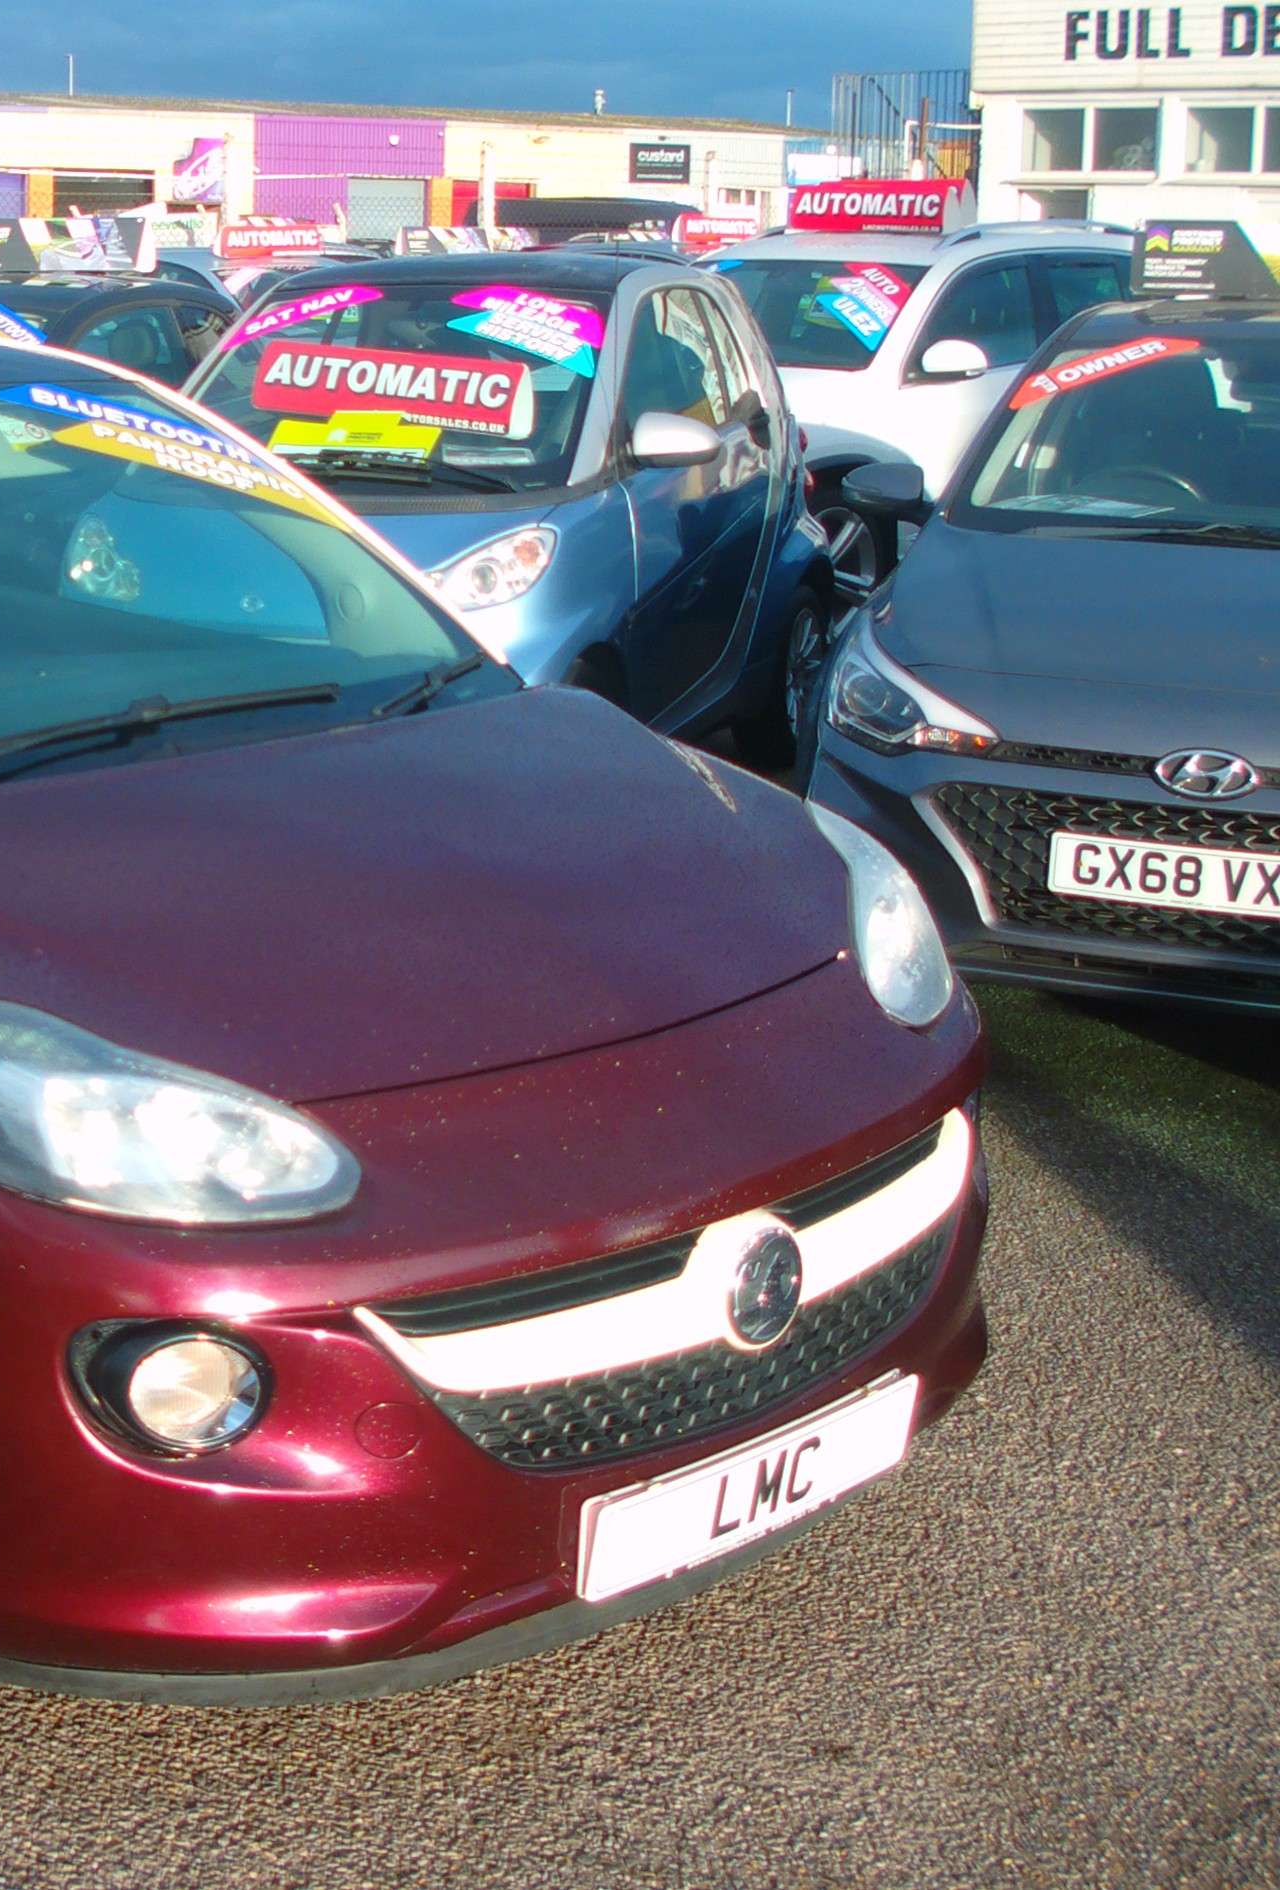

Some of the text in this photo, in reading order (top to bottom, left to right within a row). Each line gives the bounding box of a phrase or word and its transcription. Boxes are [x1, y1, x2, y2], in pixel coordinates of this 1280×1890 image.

[1065, 7, 1192, 60] FULL
[637, 149, 684, 162] custard
[796, 192, 940, 217] AUTOMATIC
[227, 230, 318, 247] AUTOMATIC
[687, 220, 757, 234] AUTOMATIC
[860, 268, 900, 295] AUTO
[245, 308, 295, 335] SAT
[301, 290, 353, 315] NAV
[480, 297, 581, 335] MILEAGE
[514, 293, 567, 315] LOW
[832, 296, 881, 337] ULEZ
[476, 324, 575, 361] HISTORY
[488, 313, 585, 355] SERVICE
[264, 353, 511, 408] AUTOMATIC
[1031, 341, 1168, 393] 1 OWNER
[30, 387, 253, 464] BLUETOOTH
[90, 421, 305, 499] PANORAMIC
[155, 453, 255, 491] ROOF
[1072, 843, 1203, 897] GX68
[709, 1436, 821, 1540] LMC
